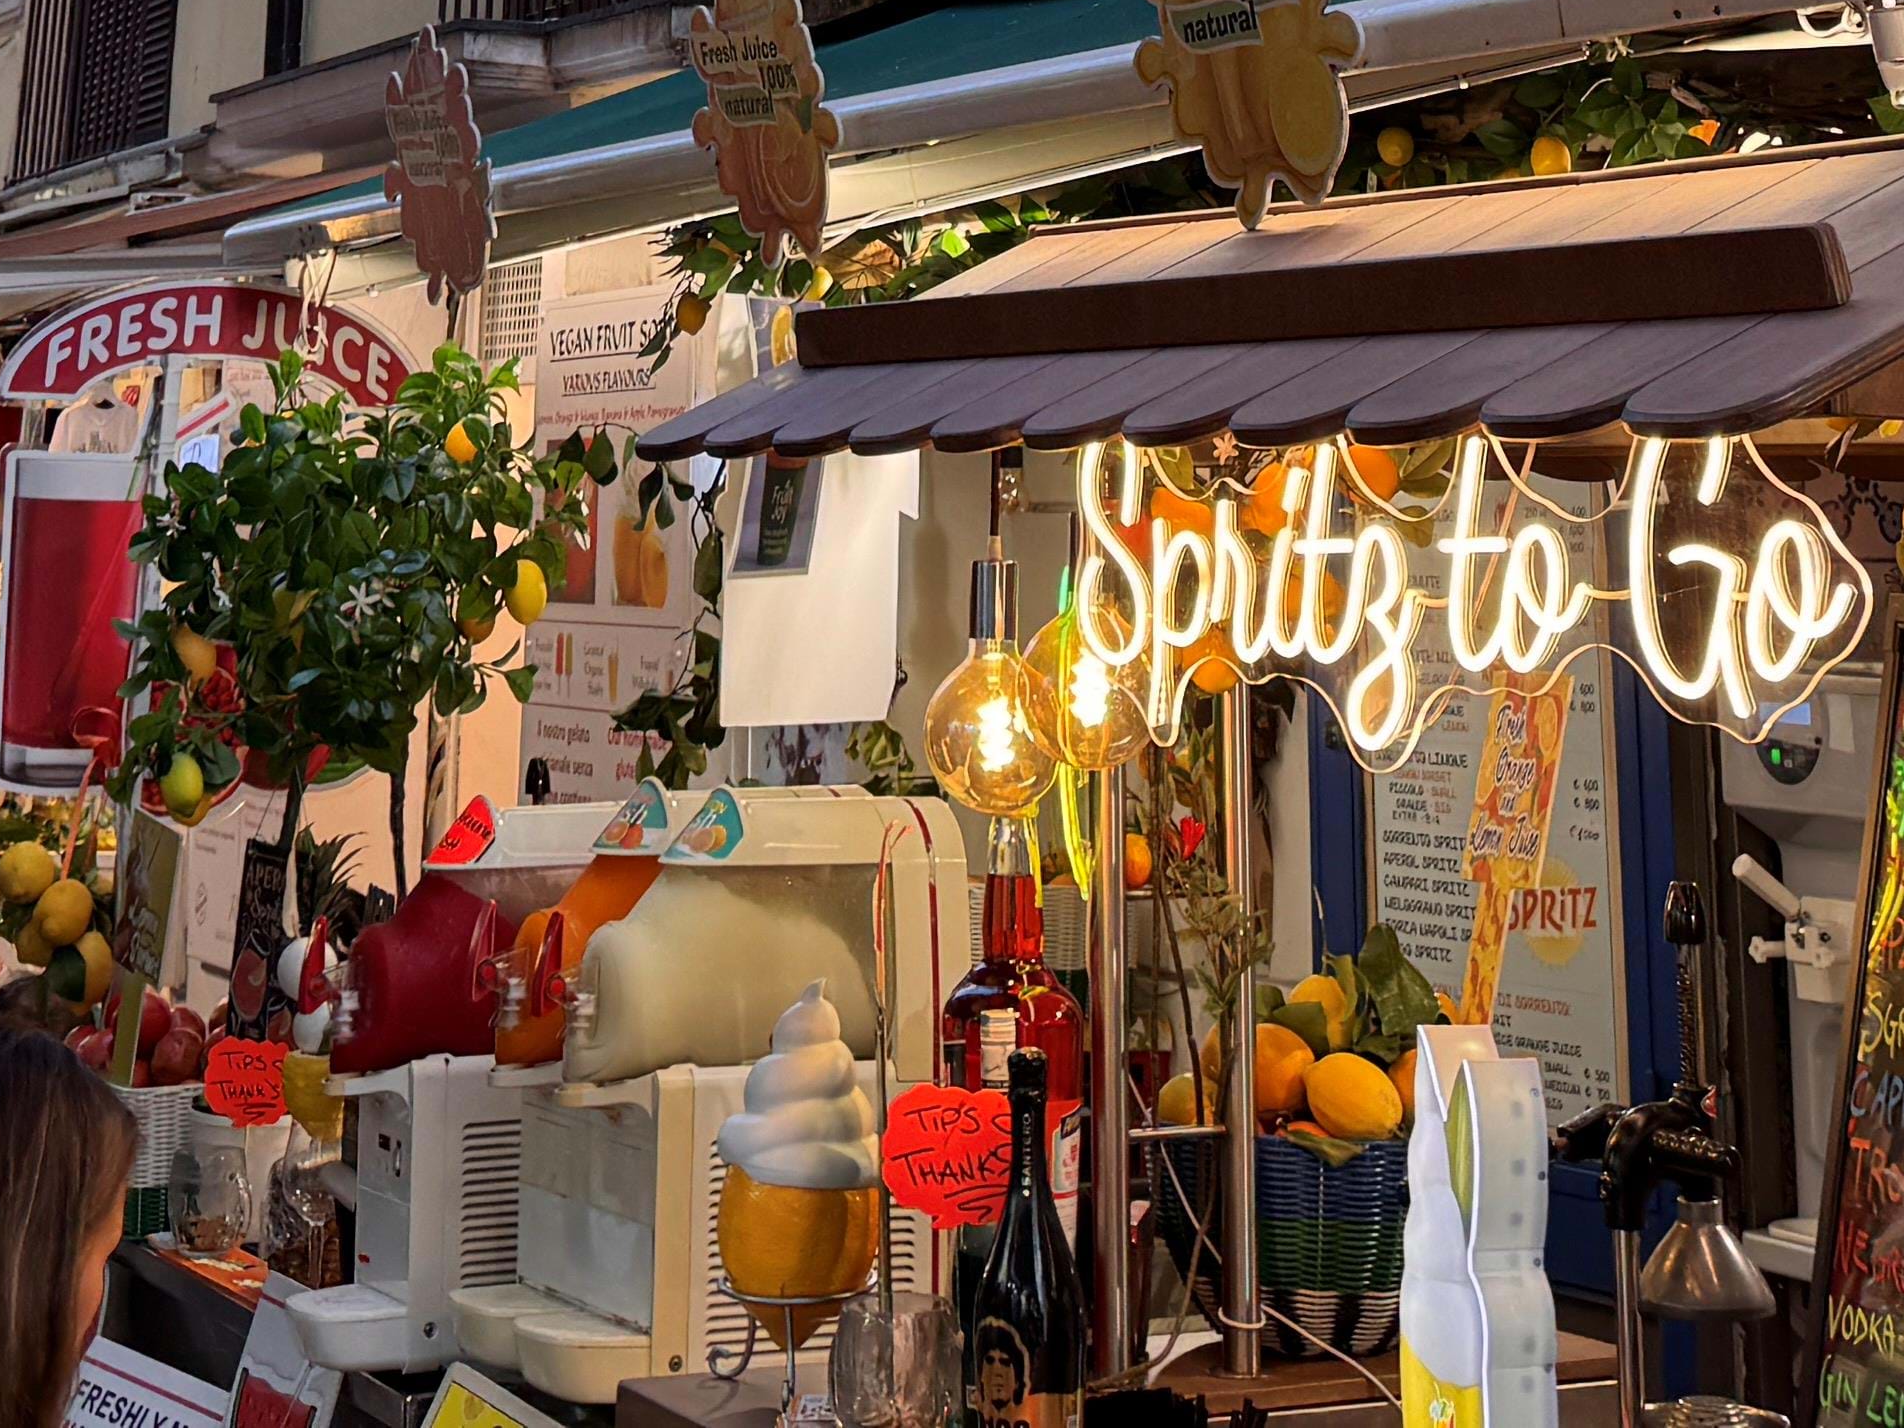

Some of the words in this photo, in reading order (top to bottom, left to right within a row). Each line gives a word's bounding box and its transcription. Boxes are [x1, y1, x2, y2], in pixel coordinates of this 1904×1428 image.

[1182, 0, 1258, 44] natural
[699, 37, 738, 66] Fresh
[741, 34, 778, 61] Juice
[758, 63, 798, 90] 100%
[724, 89, 774, 116] natural
[45, 294, 223, 388] FRESH
[550, 325, 594, 357] VEGAN
[596, 320, 636, 352] FRUIT
[1078, 438, 1426, 750] Spritz
[1626, 437, 1858, 720] Go
[1433, 832, 1467, 852] SPRIT
[1446, 903, 1477, 921] SPRIT
[1021, 1113, 1032, 1185] SANTERO
[1819, 1354, 1860, 1415] GIN
